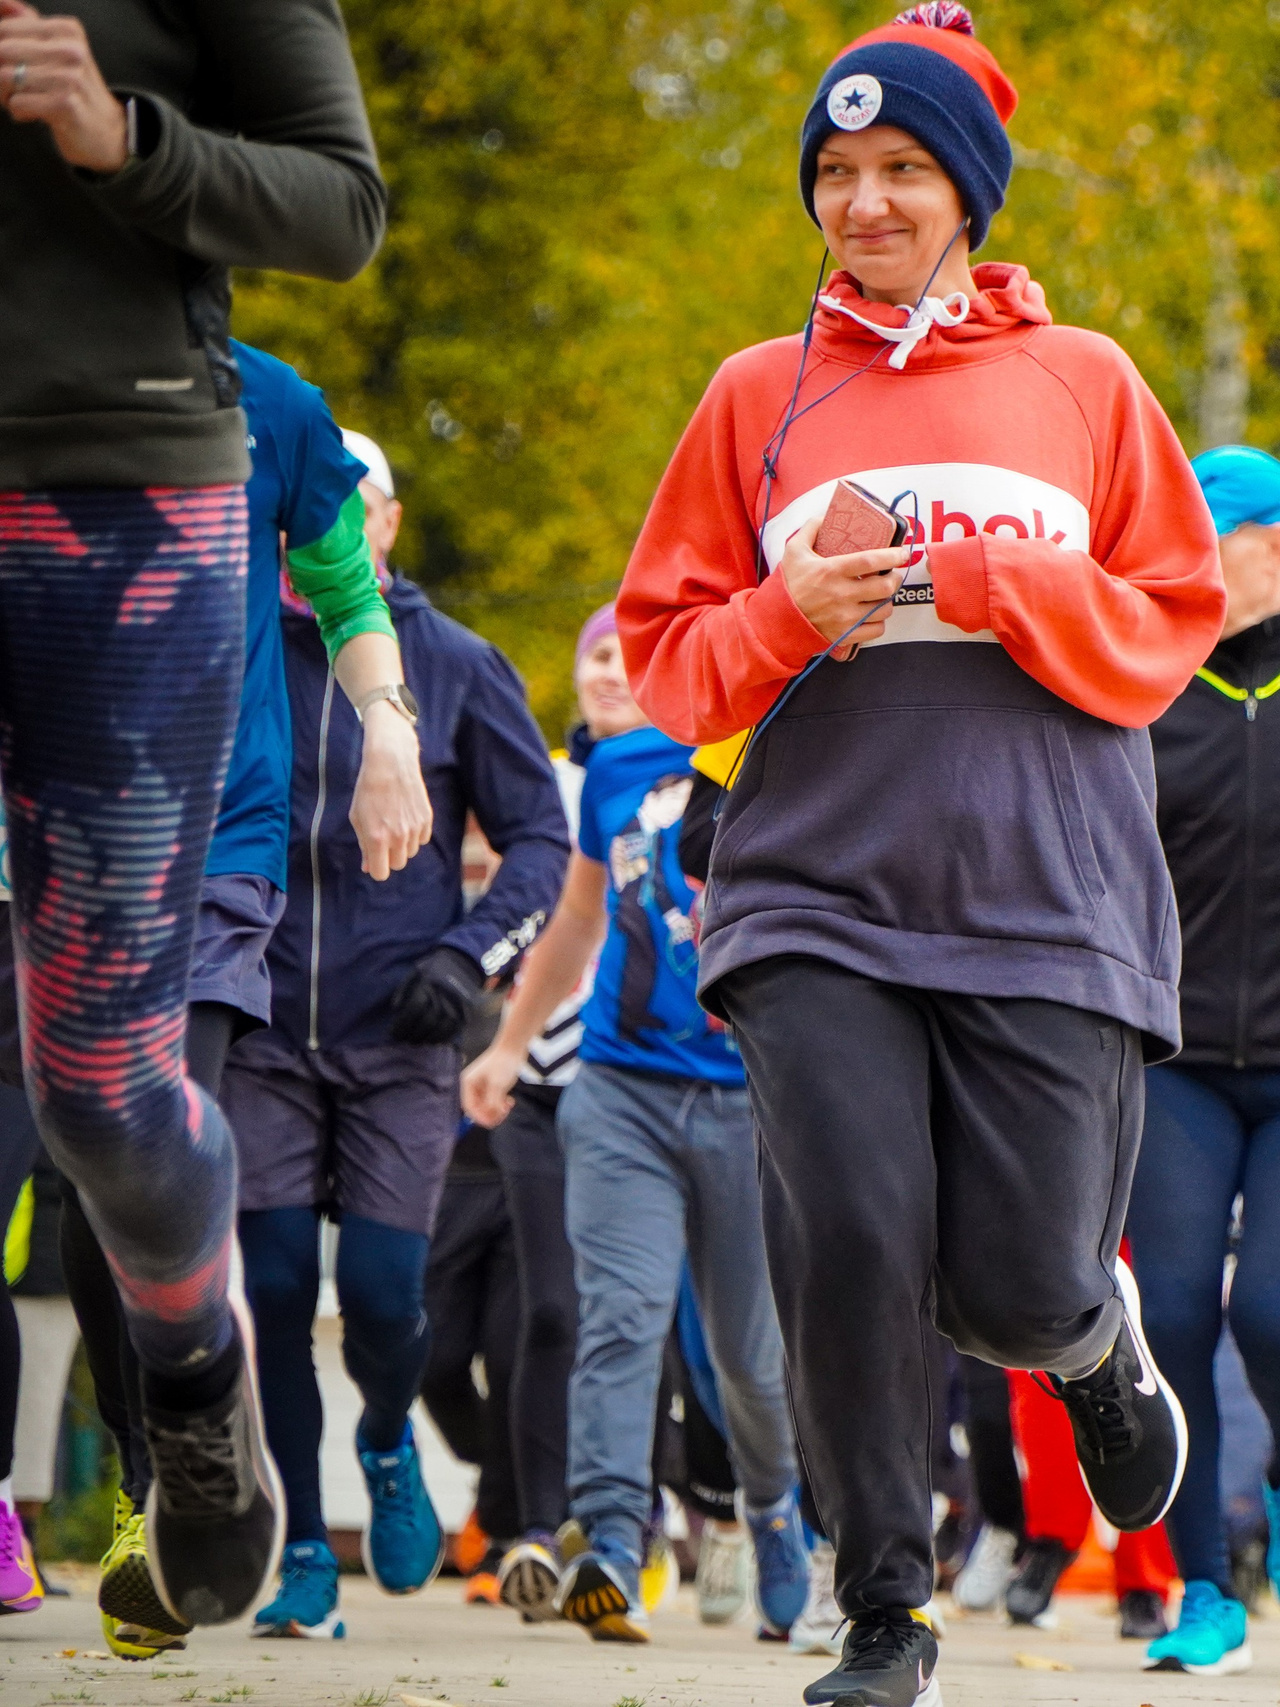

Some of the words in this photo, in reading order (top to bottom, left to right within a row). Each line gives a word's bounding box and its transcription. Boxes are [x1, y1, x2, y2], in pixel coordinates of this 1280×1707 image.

[837, 112, 849, 123] ALL
[851, 108, 871, 123] STAR
[895, 586, 934, 603] Reeb
